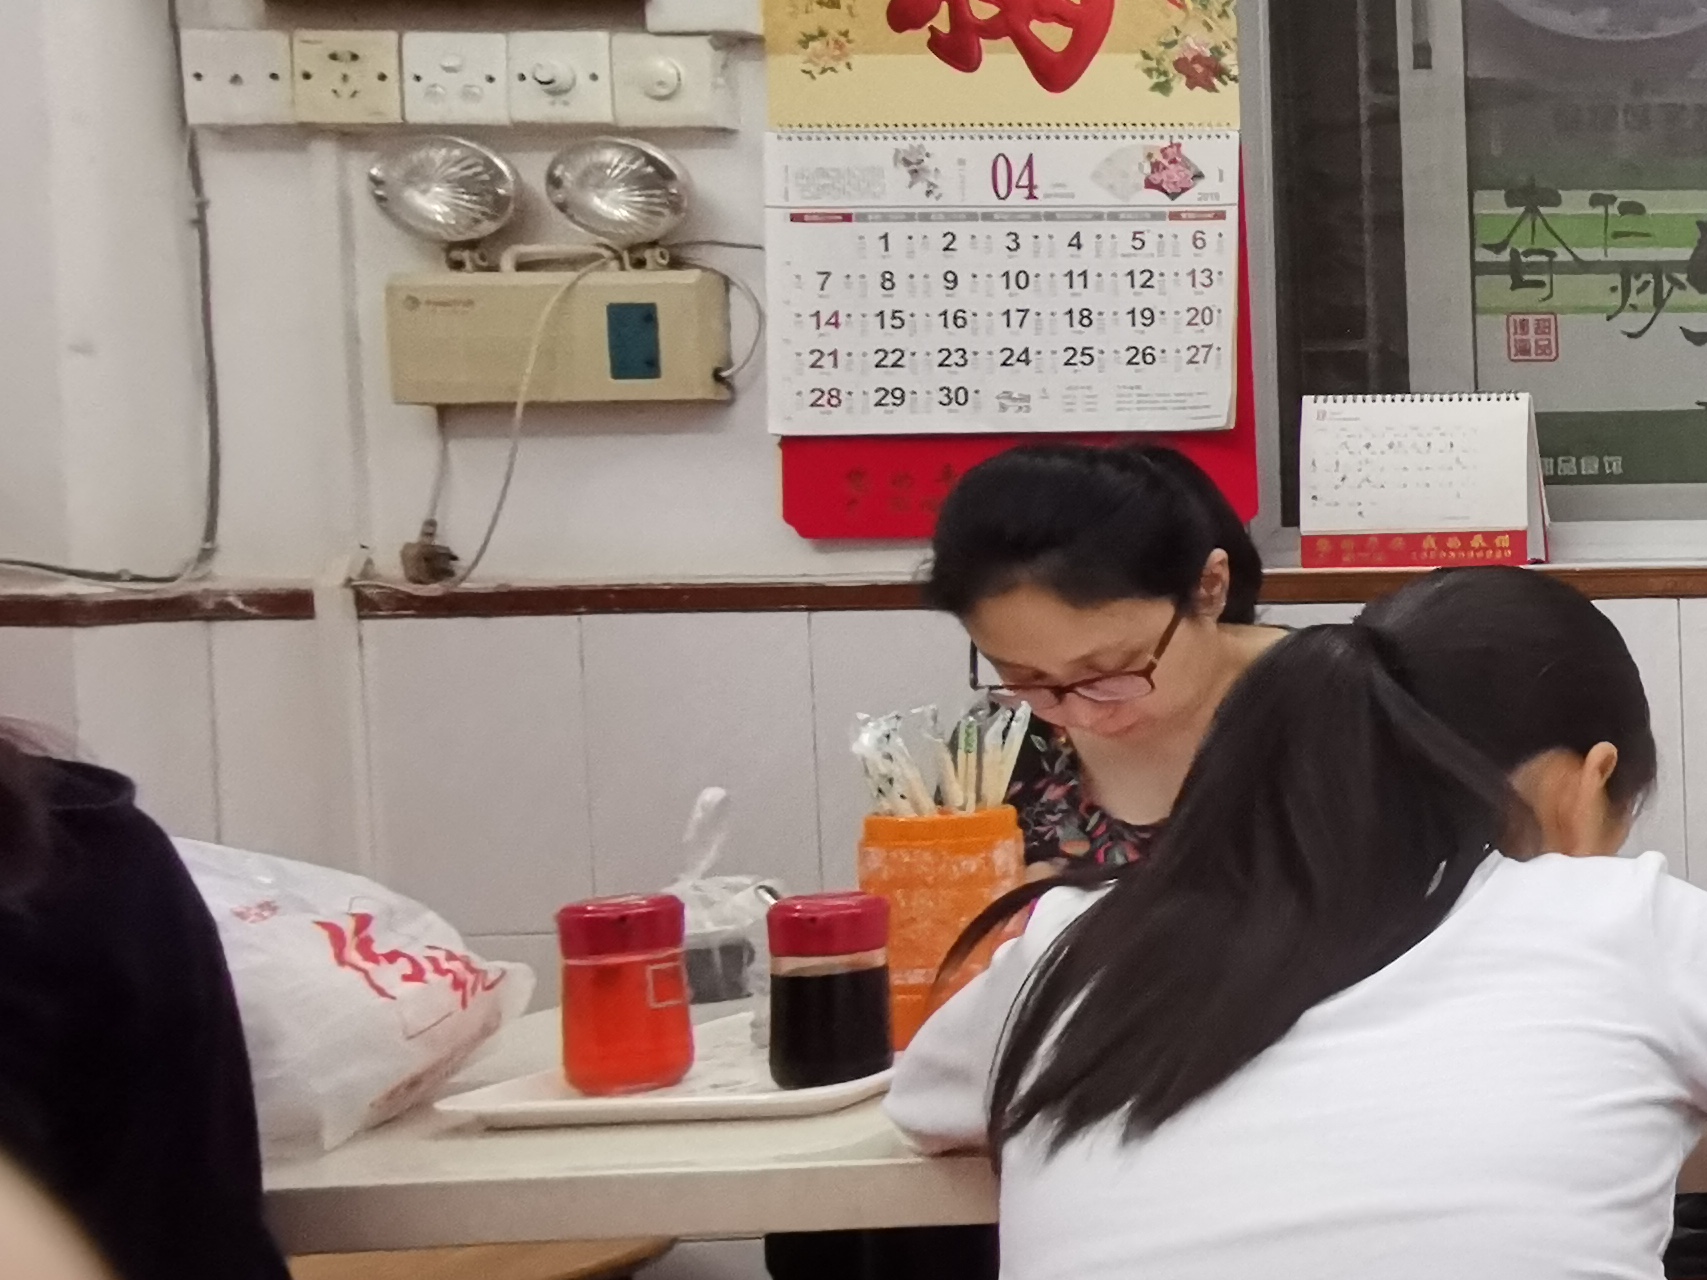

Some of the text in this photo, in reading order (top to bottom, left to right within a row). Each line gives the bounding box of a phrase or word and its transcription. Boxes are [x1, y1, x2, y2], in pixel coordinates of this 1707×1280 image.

[991, 152, 1040, 201] 04
[878, 229, 1207, 253] 1 2 3 4 5 6
[816, 267, 1214, 292] 7 8 9 10 11 12 13
[809, 305, 1214, 331] 14 15 16 17 18 19 20
[808, 343, 1214, 369] 21 22 23 24 25 26 27
[809, 385, 969, 409] 28 29 30
